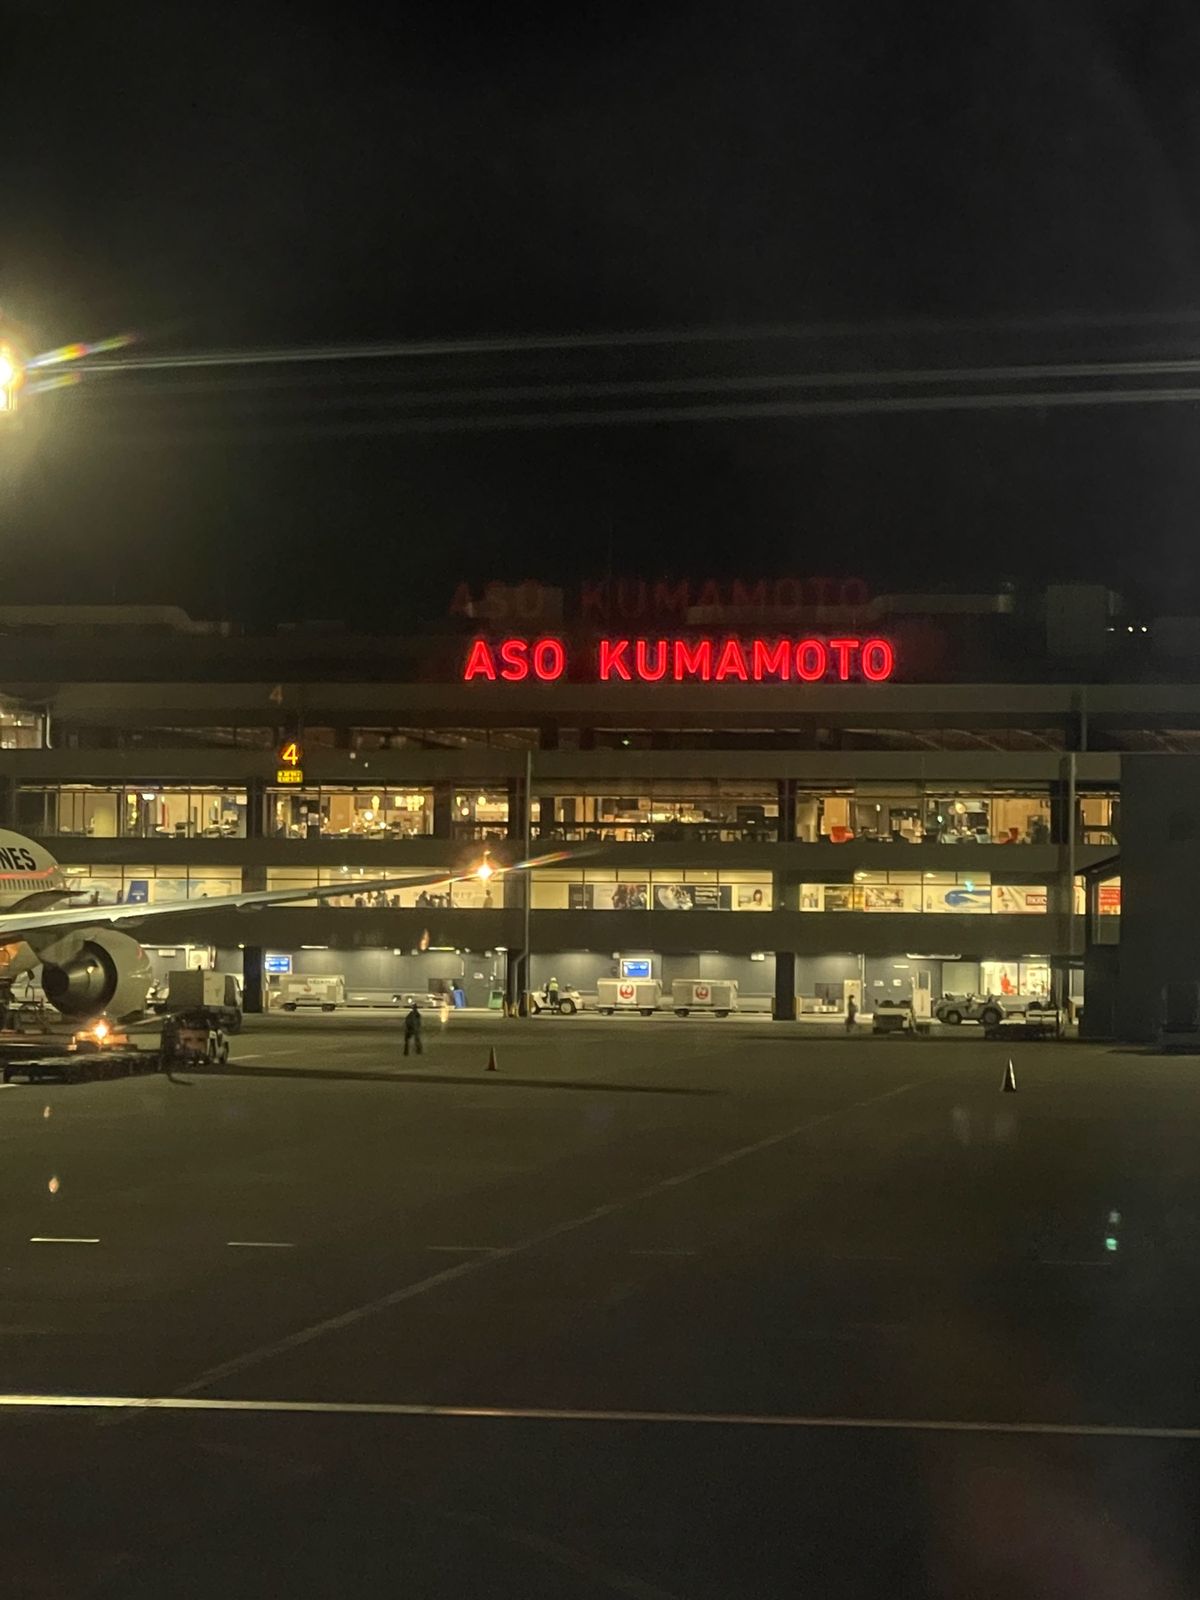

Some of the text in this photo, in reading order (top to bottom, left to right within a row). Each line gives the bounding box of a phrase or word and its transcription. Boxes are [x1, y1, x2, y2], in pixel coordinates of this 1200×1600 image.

[464, 637, 894, 681] ASO KUMAMOTO
[282, 743, 299, 765] 4
